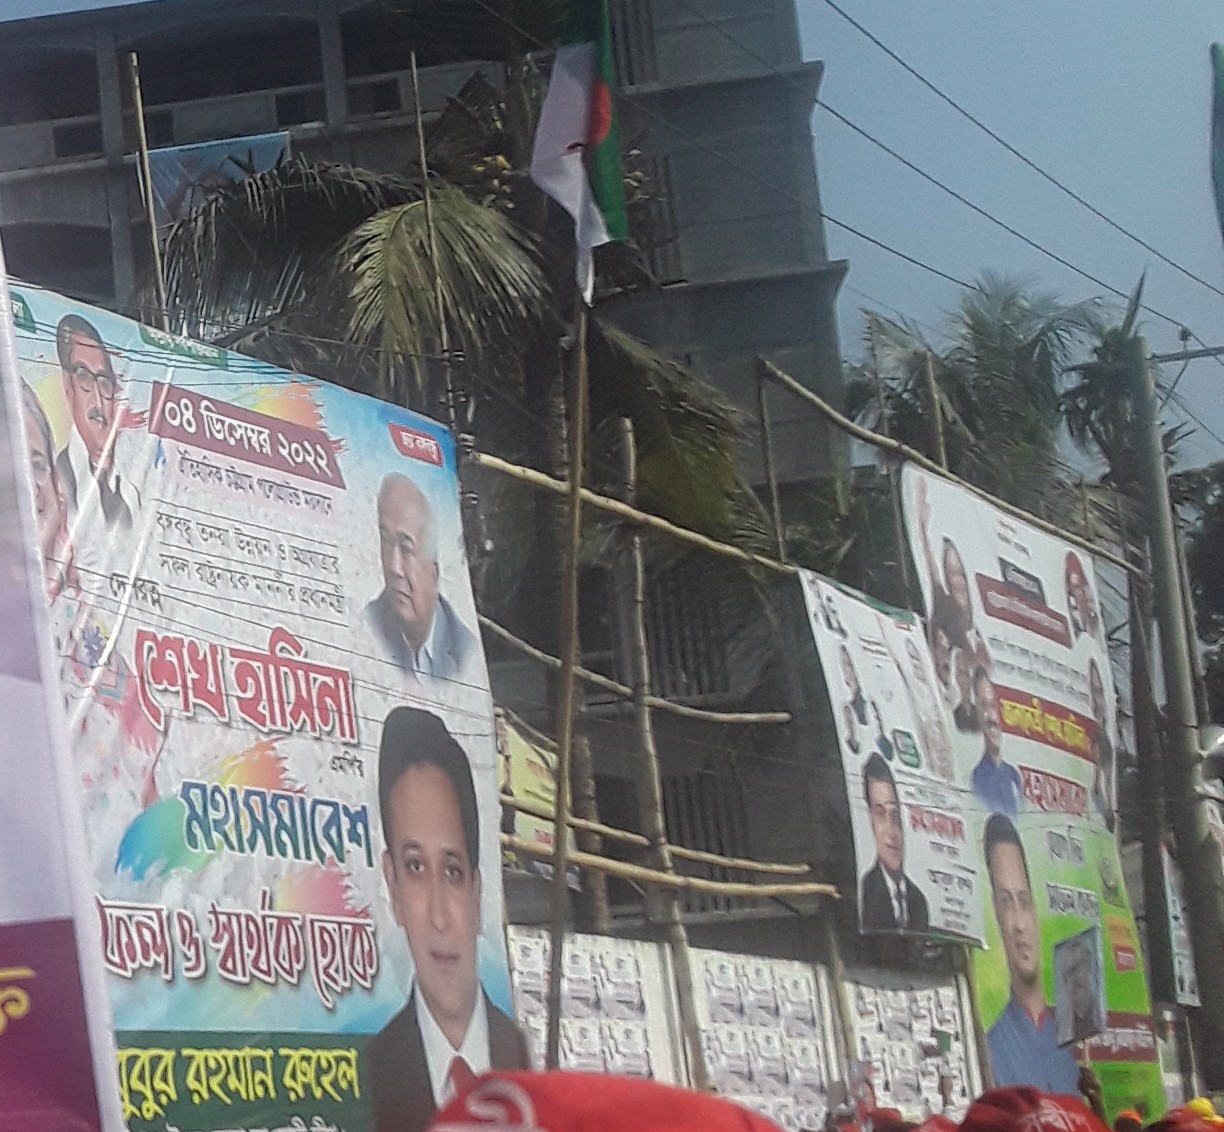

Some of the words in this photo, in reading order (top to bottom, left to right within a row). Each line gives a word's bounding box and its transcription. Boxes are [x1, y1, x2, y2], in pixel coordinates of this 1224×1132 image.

[163, 397, 197, 435] ০৪
[199, 399, 273, 458] ডিসেম্বর
[277, 432, 333, 478] ২০২২
[134, 628, 230, 731] শেখ
[229, 624, 359, 744] হাসিনা
[179, 778, 375, 868] মহাসমাবেশ
[95, 892, 173, 981] ফল
[176, 908, 206, 978] ও
[305, 912, 379, 1009] হোক
[180, 1045, 276, 1106] রহমান
[278, 1046, 362, 1104] রুহেল
